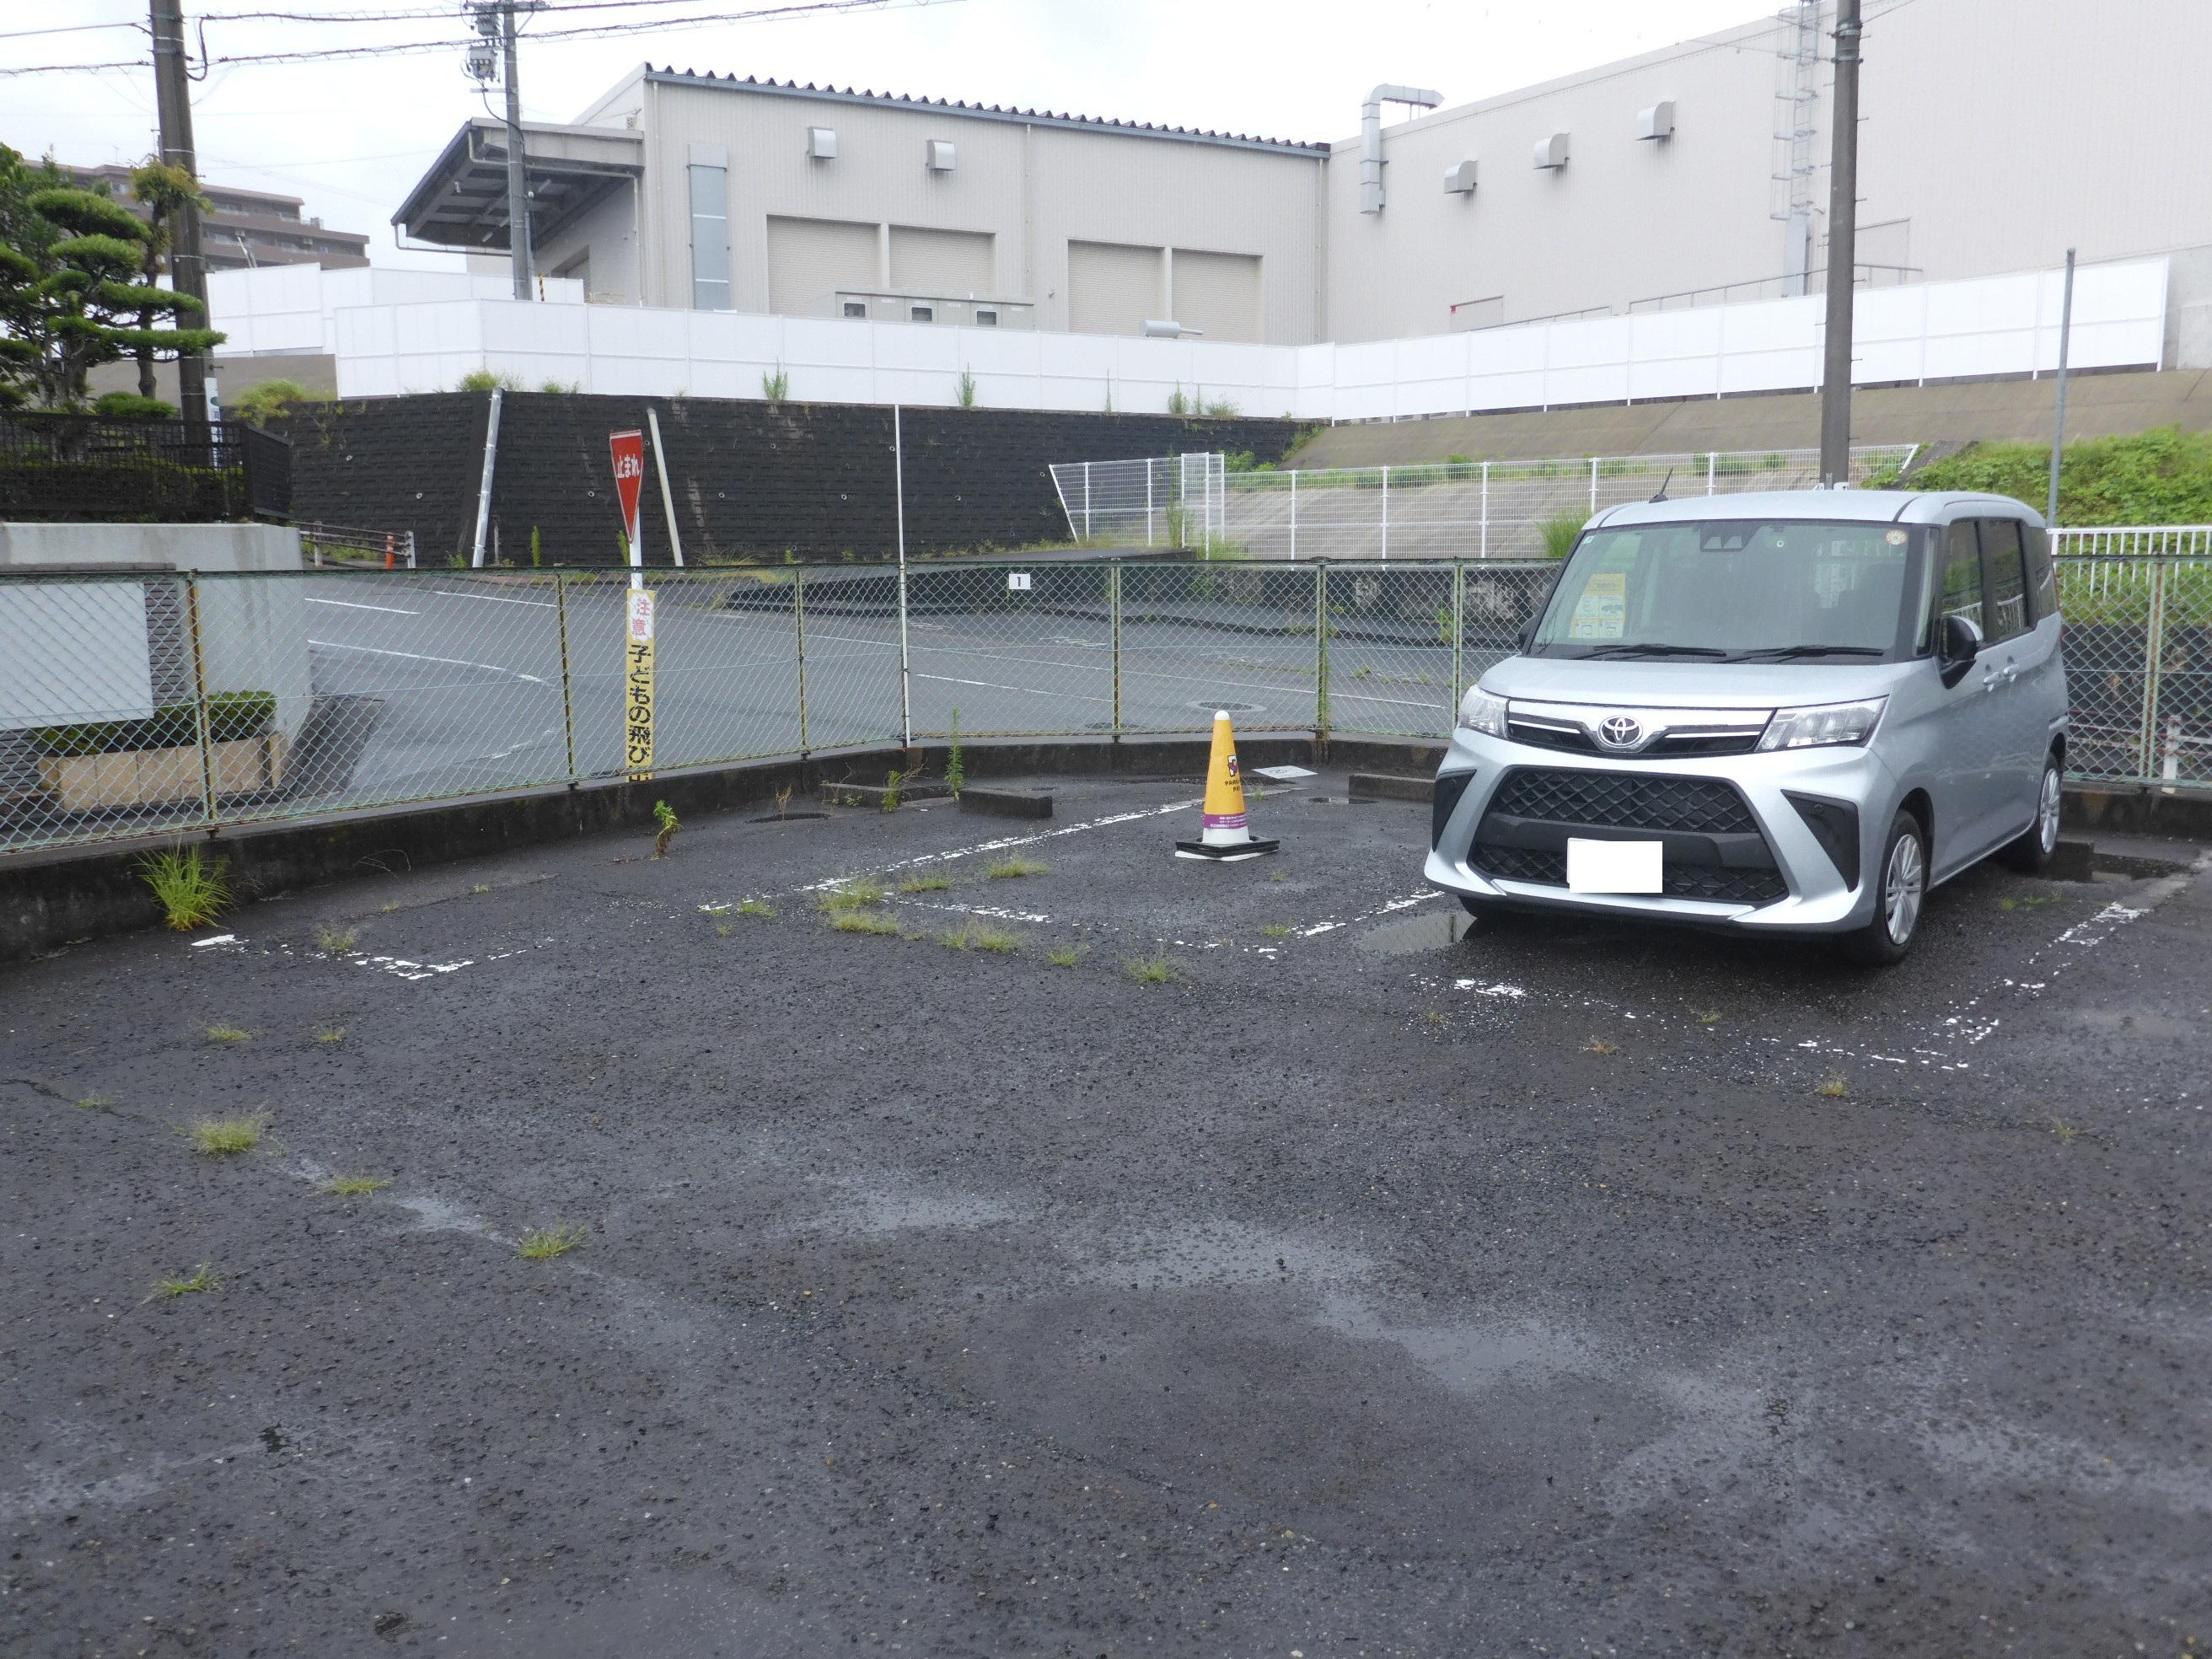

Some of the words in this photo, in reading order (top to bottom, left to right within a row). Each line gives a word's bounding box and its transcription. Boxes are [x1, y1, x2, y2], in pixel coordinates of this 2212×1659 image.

[617, 454, 640, 478] 止まれ
[1017, 576, 1022, 587] 1
[632, 599, 650, 636] 注意
